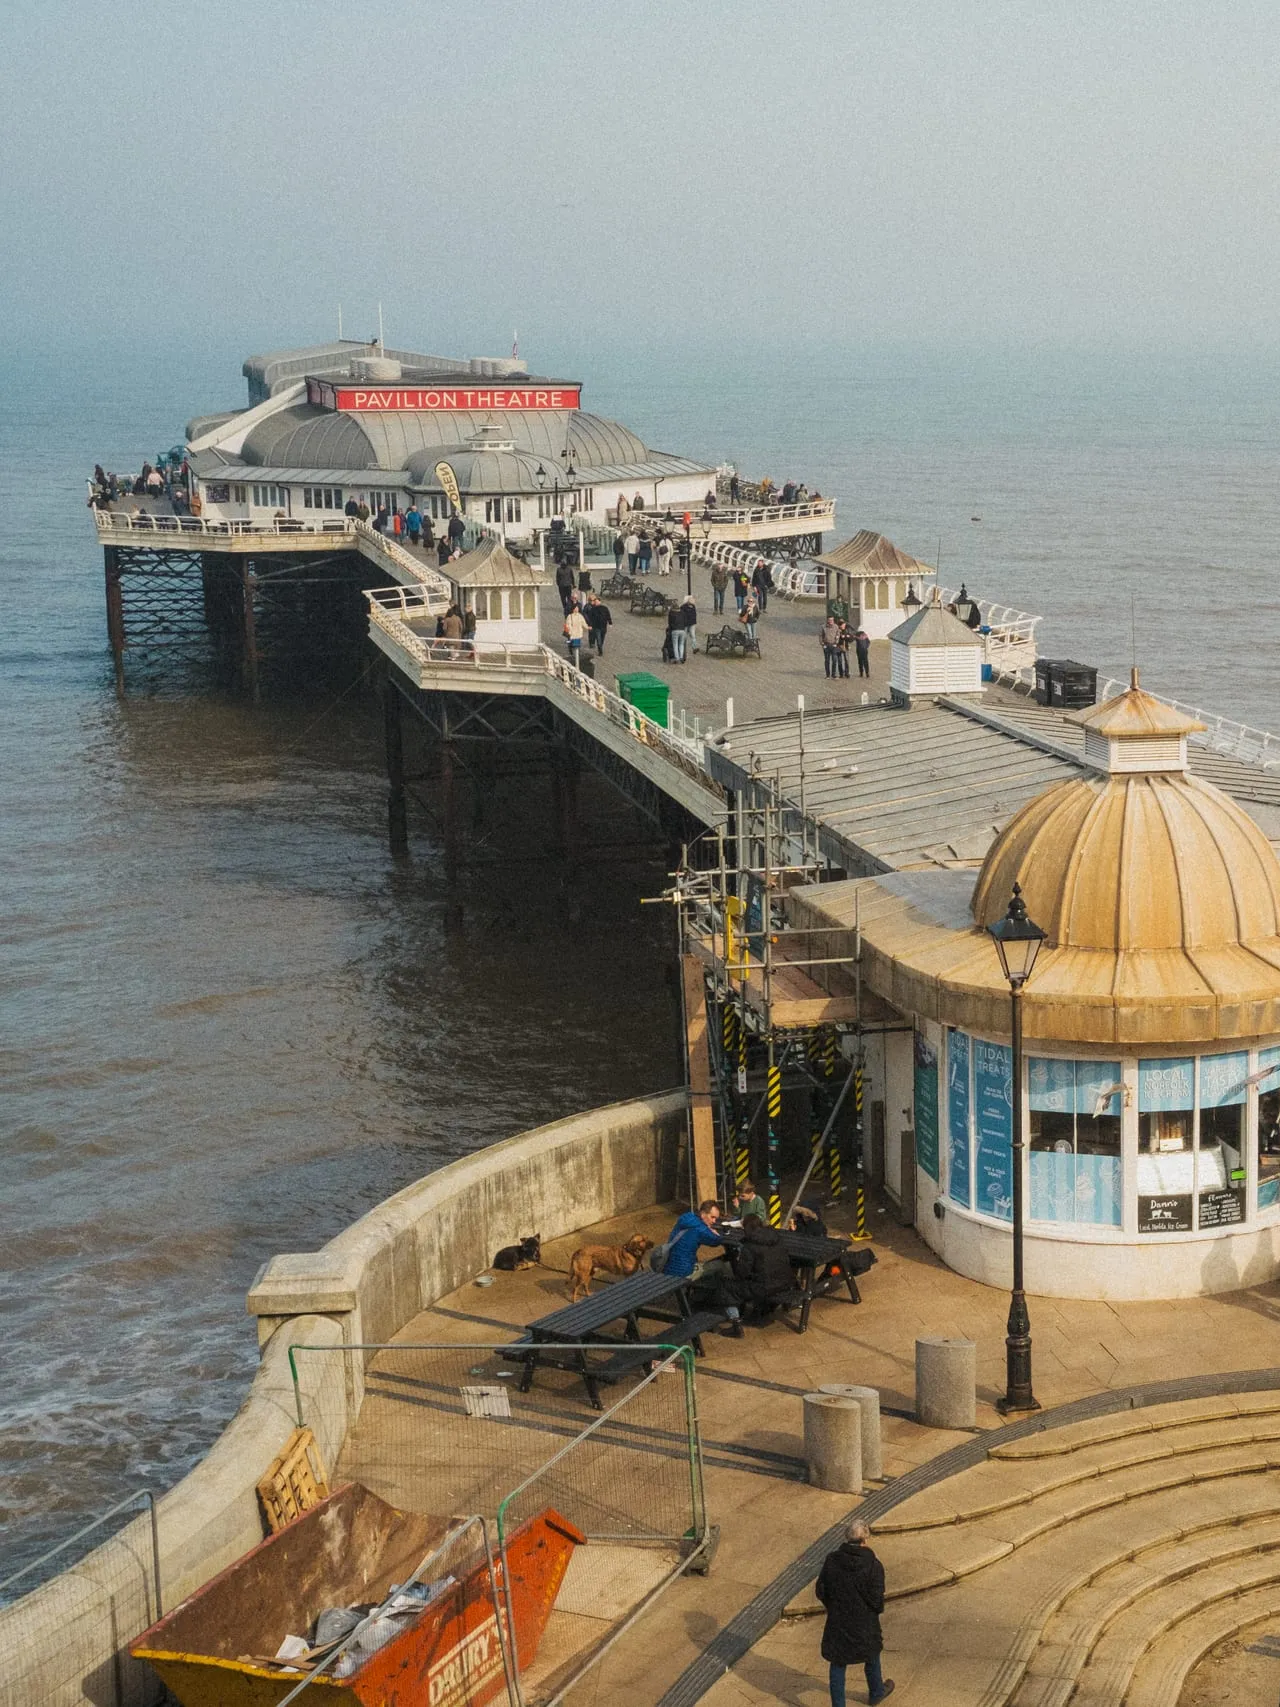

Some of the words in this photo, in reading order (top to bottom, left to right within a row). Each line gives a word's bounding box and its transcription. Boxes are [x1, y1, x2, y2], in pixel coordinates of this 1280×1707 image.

[355, 391, 457, 408] PAVILION
[464, 391, 563, 408] THEATRE
[977, 1045, 1010, 1063] TIDAL
[977, 1060, 1010, 1078] TREATS
[1145, 1069, 1188, 1081] LOCAL
[1144, 1080, 1190, 1090] NORFOLK
[1150, 1200, 1178, 1209] Dann's
